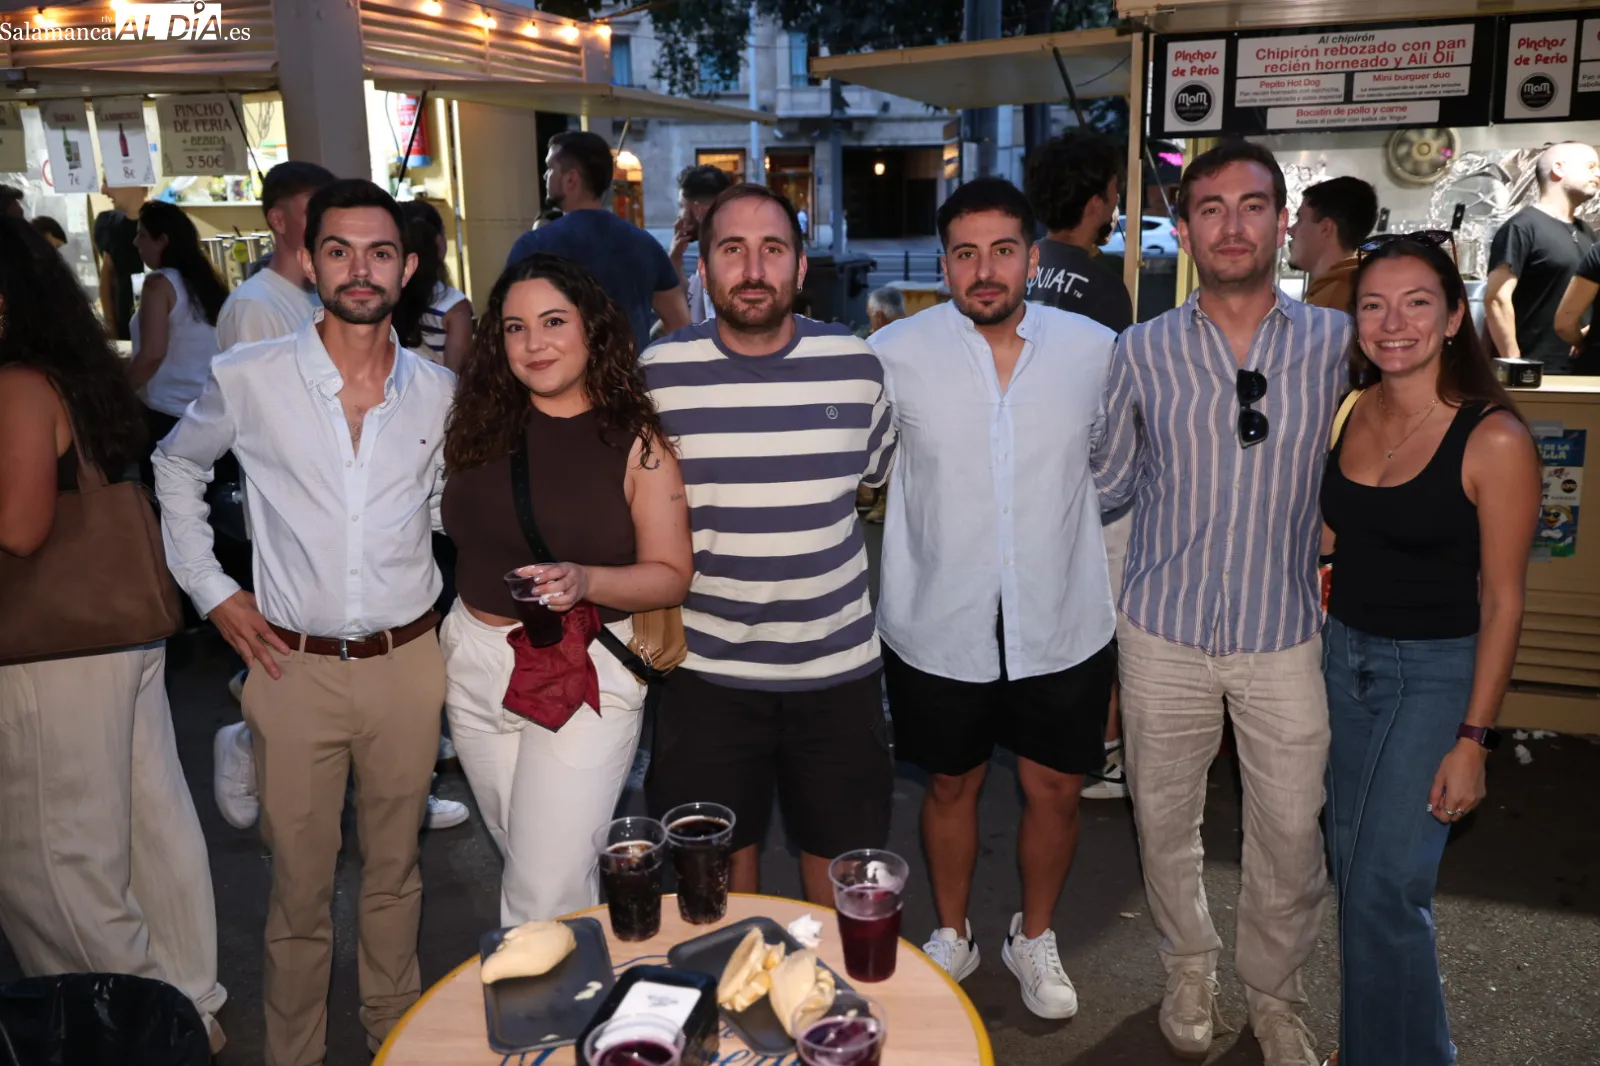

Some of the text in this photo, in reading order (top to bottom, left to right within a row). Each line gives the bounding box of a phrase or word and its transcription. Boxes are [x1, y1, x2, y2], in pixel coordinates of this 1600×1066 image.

[1318, 32, 1375, 45] Al chipirón
[1518, 37, 1567, 51] Pinchos
[1255, 38, 1466, 61] Chipirón rebozado con pan
[1174, 50, 1217, 63] Pinchos
[1264, 51, 1455, 73] recién horneado y Ali Oli
[1514, 54, 1530, 66] de
[1171, 67, 1186, 77] de
[1372, 71, 1451, 83] Mini burguer duo
[1260, 78, 1321, 89] Pepito Hot Dog
[174, 102, 224, 117] PINCHO
[1334, 107, 1345, 115] de
[1347, 106, 1370, 116] pollo
[1380, 105, 1408, 113] carne
[174, 118, 232, 133] DE FERIA
